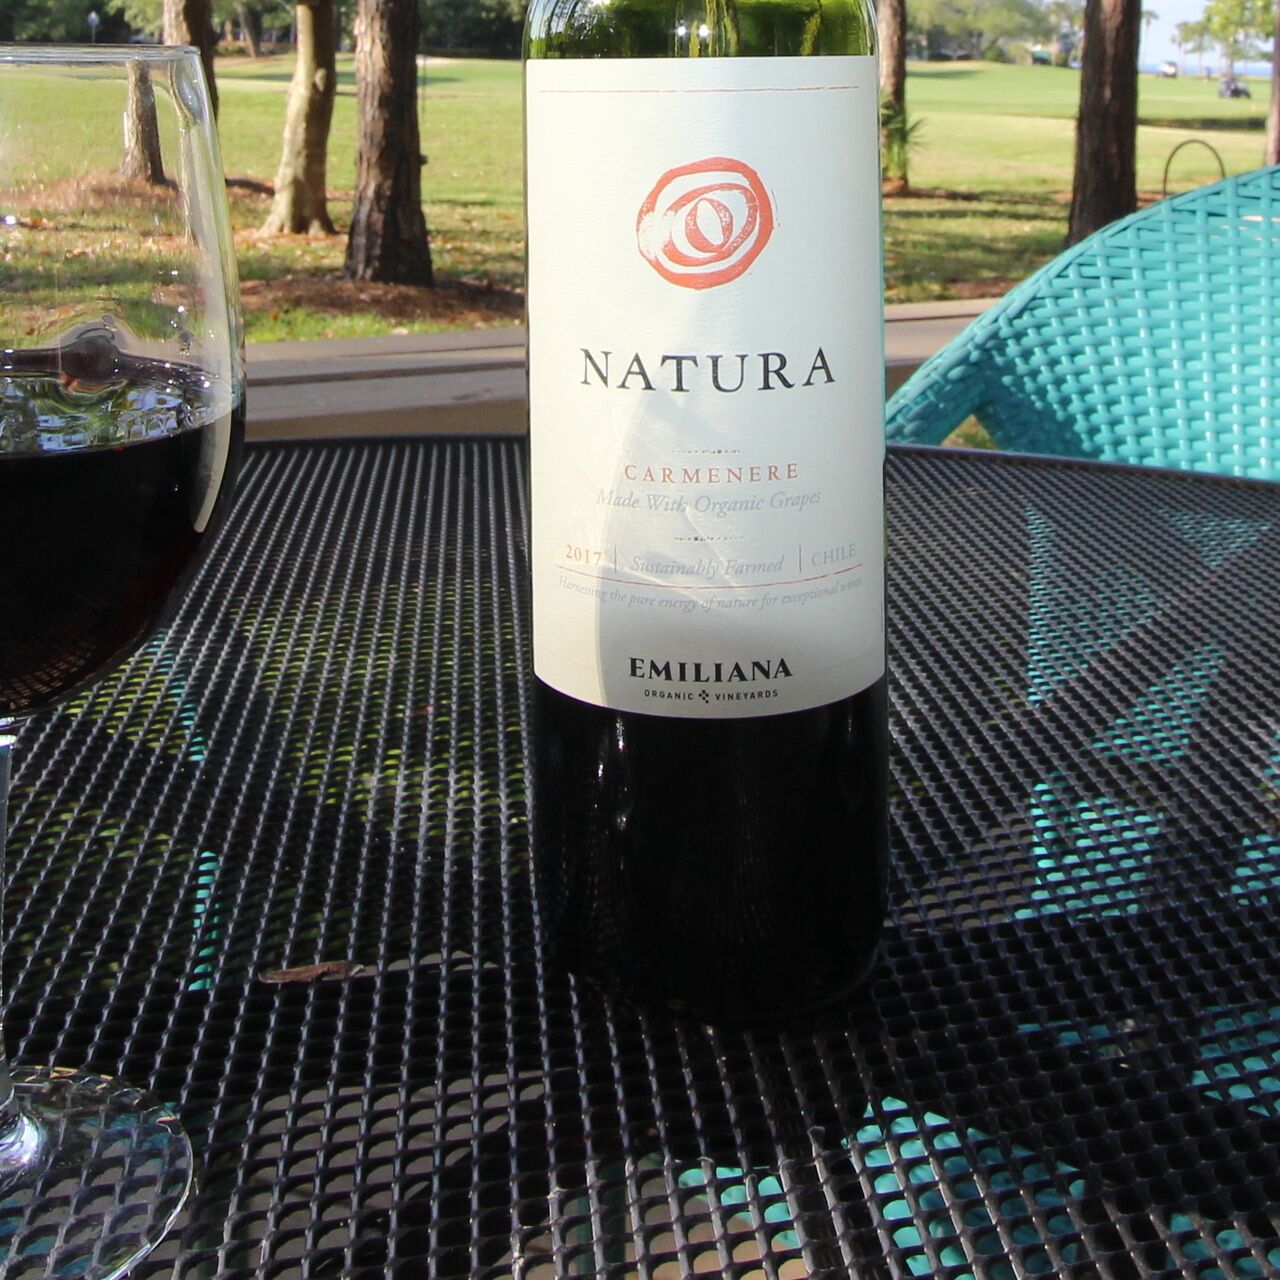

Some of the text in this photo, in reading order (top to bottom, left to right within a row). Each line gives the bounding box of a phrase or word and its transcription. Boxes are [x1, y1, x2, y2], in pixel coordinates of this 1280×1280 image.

[579, 346, 836, 394] NATURA
[624, 463, 799, 484] CARMENERE
[595, 488, 822, 518] Made With Organic Grapes
[565, 543, 857, 580] 2017 Sustainably Farmed CHILE
[610, 588, 626, 603] the
[628, 594, 656, 609] pure
[658, 597, 697, 612] energy
[702, 595, 716, 612] of
[717, 596, 759, 609] nature
[759, 593, 778, 611] for
[628, 657, 795, 683] EMILIANA
[644, 688, 778, 701] ORGANIC VINEYARDS
